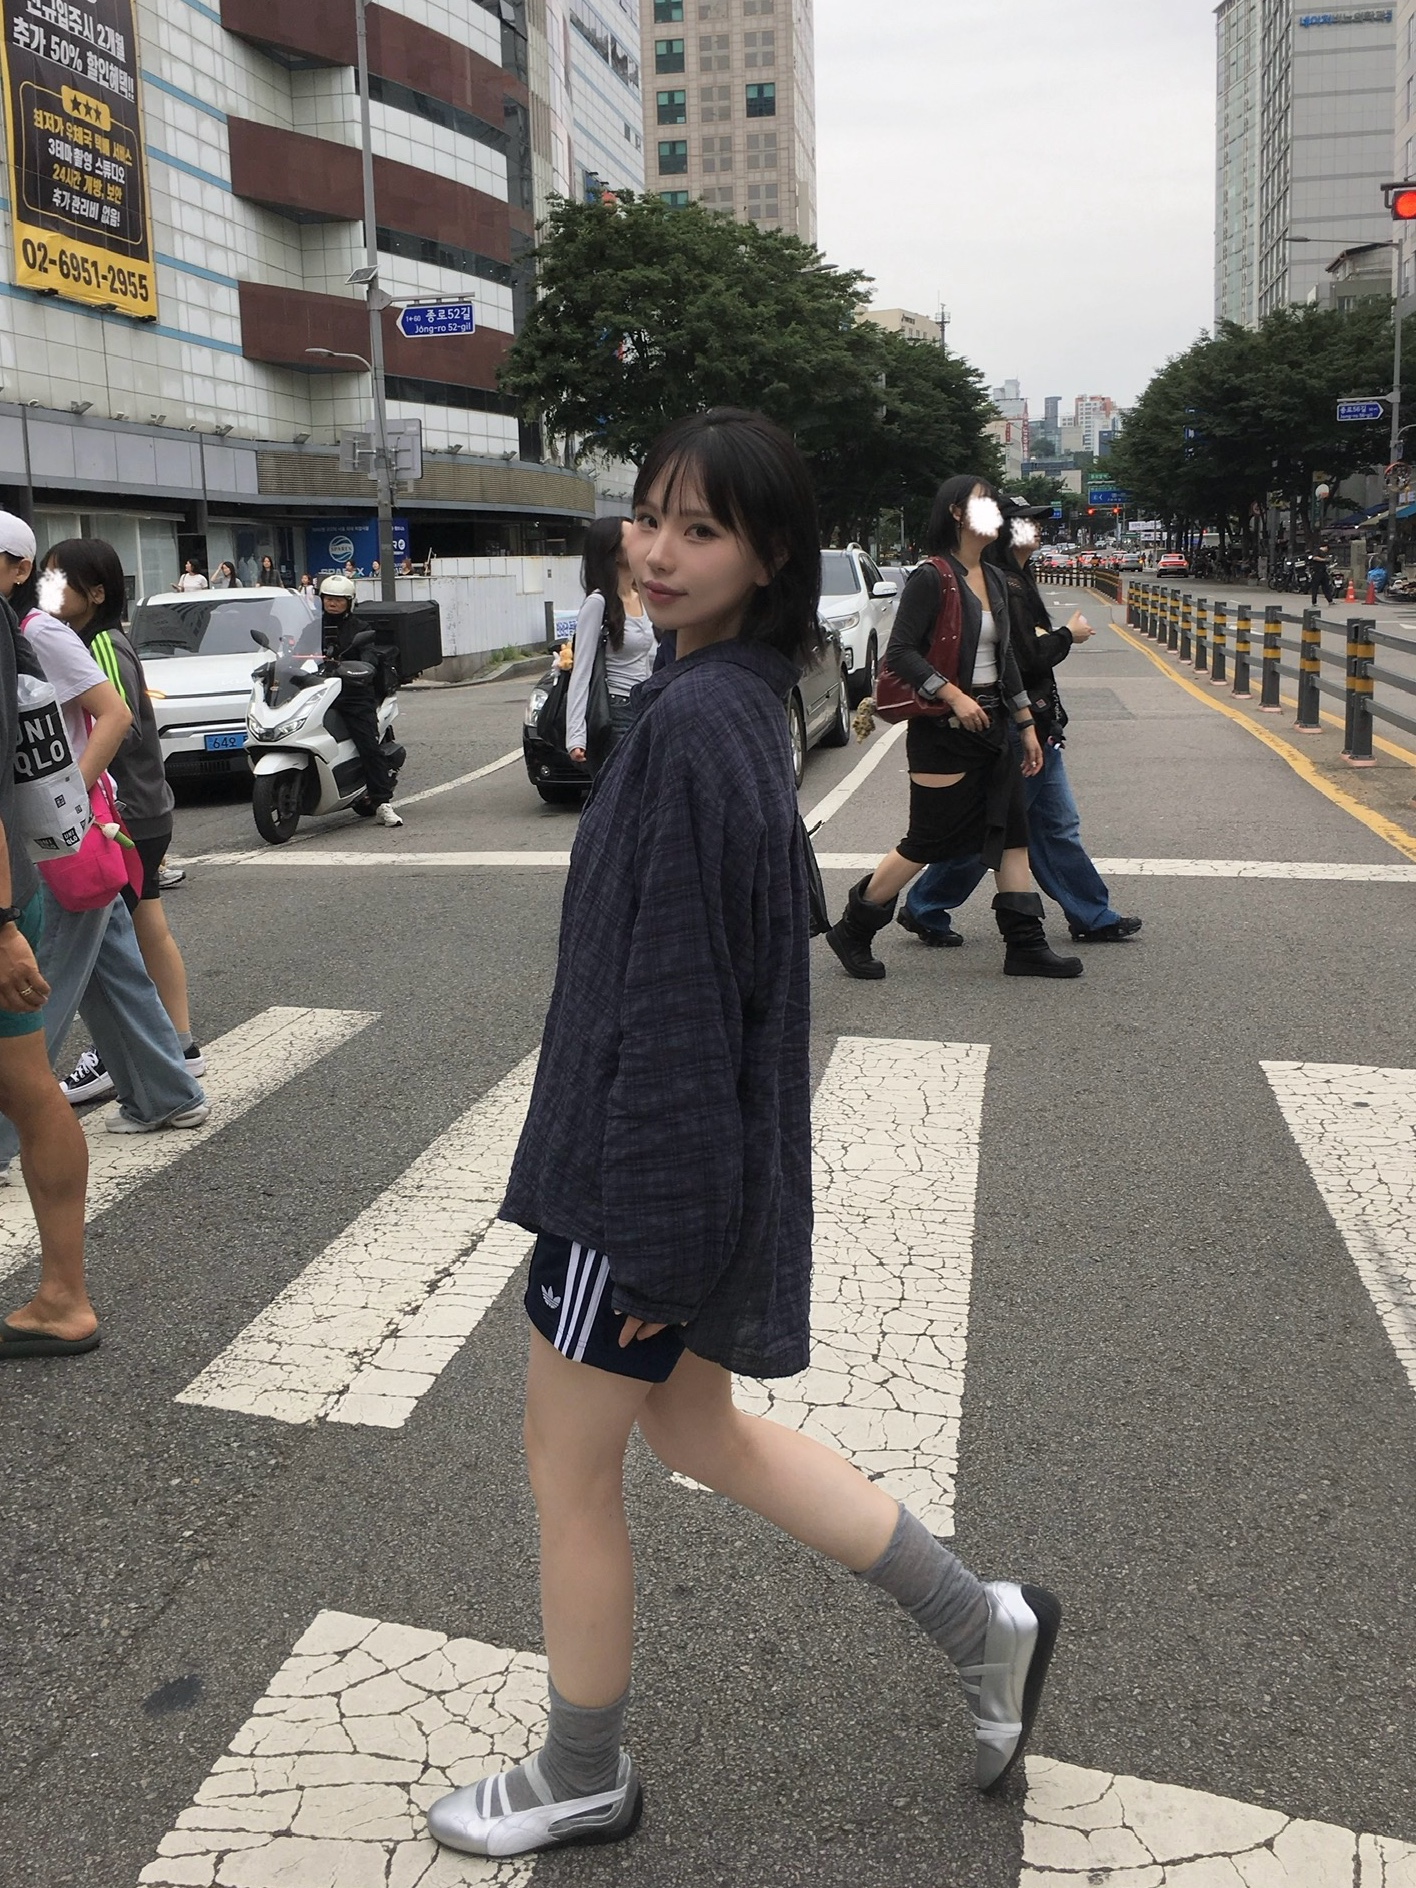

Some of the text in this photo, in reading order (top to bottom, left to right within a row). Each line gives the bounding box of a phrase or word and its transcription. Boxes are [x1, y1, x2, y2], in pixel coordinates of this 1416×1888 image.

[97, 24, 125, 61] 2개월
[13, 16, 134, 100] 추가 50% 할인혜택!!
[33, 107, 132, 166] 최저가 우체국 택배 서비스
[52, 163, 81, 190] 24시간
[107, 182, 122, 204] 보안
[95, 157, 125, 184] 스튜디오
[101, 205, 120, 227] 없음!
[22, 238, 149, 302] 02-6951-2955
[415, 322, 471, 334] Jong-ro 52-gil
[425, 306, 471, 323] 종로52길
[213, 736, 237, 749] 64오
[14, 739, 65, 777] QLO
[64, 829, 75, 839] UNI
[66, 835, 78, 844] QLO
